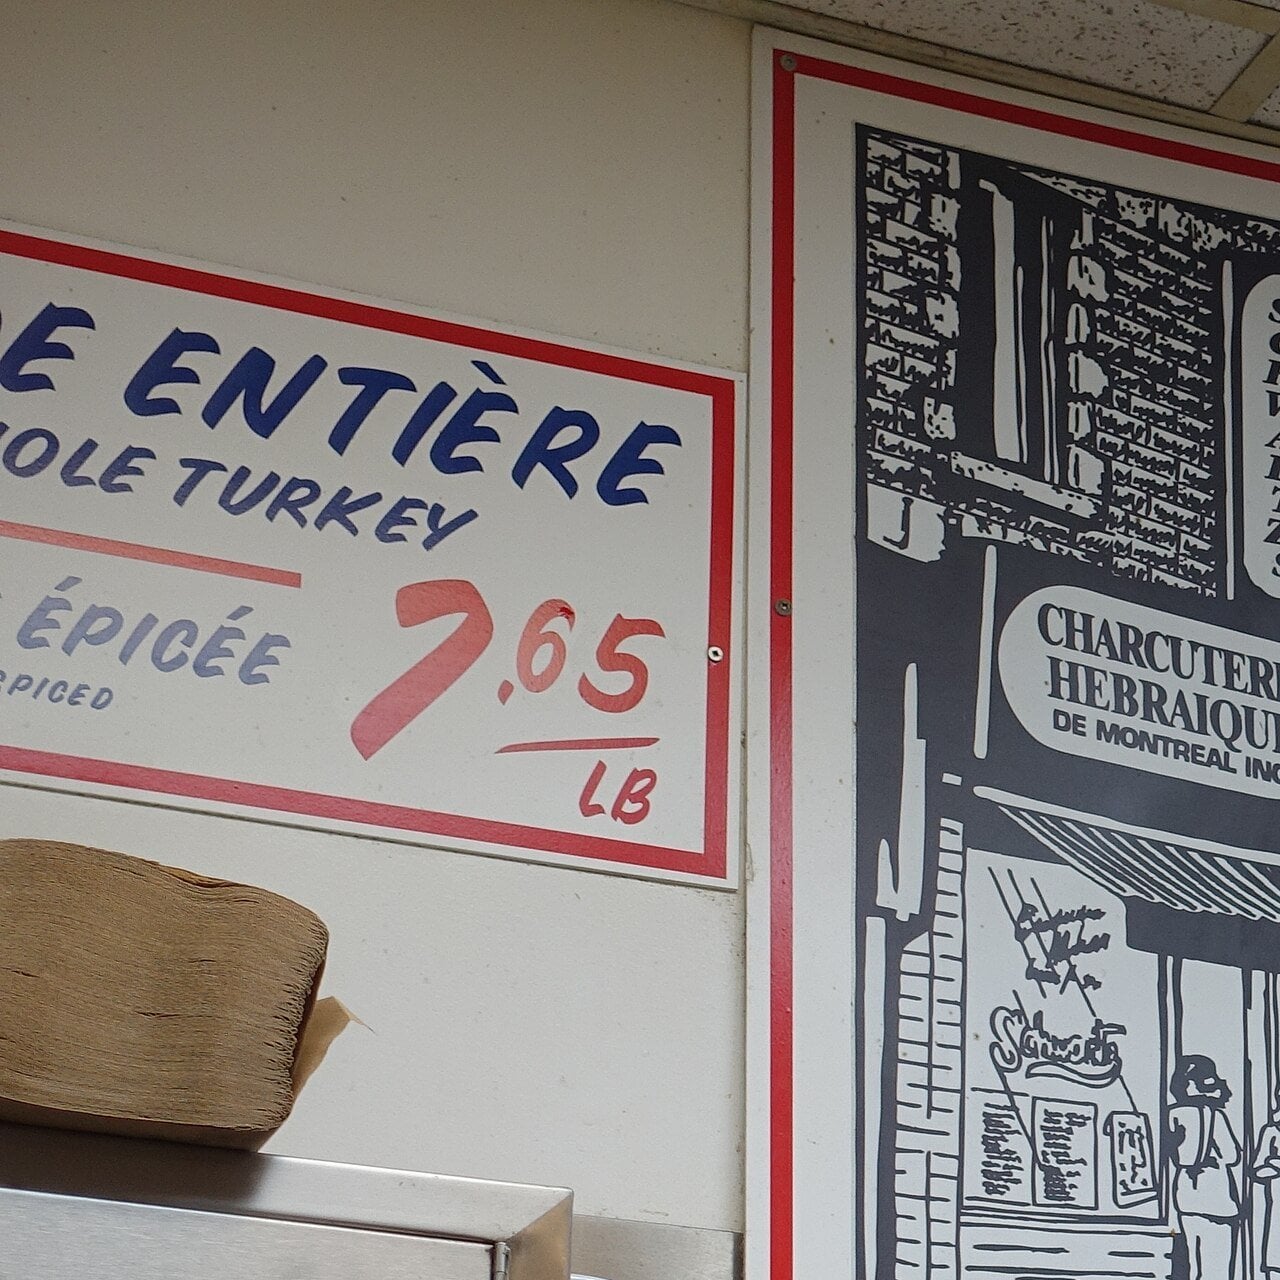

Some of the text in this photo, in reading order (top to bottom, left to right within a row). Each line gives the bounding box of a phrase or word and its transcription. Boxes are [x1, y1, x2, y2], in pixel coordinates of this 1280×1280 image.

[0, 302, 682, 506] E ENTIÈRE
[172, 456, 478, 551] TURKEY
[16, 576, 292, 685] ÉPICÉE
[350, 578, 666, 761] 7.65
[579, 759, 654, 825] LB
[1053, 708, 1087, 738] DE
[1095, 719, 1237, 776] MONTREAL
